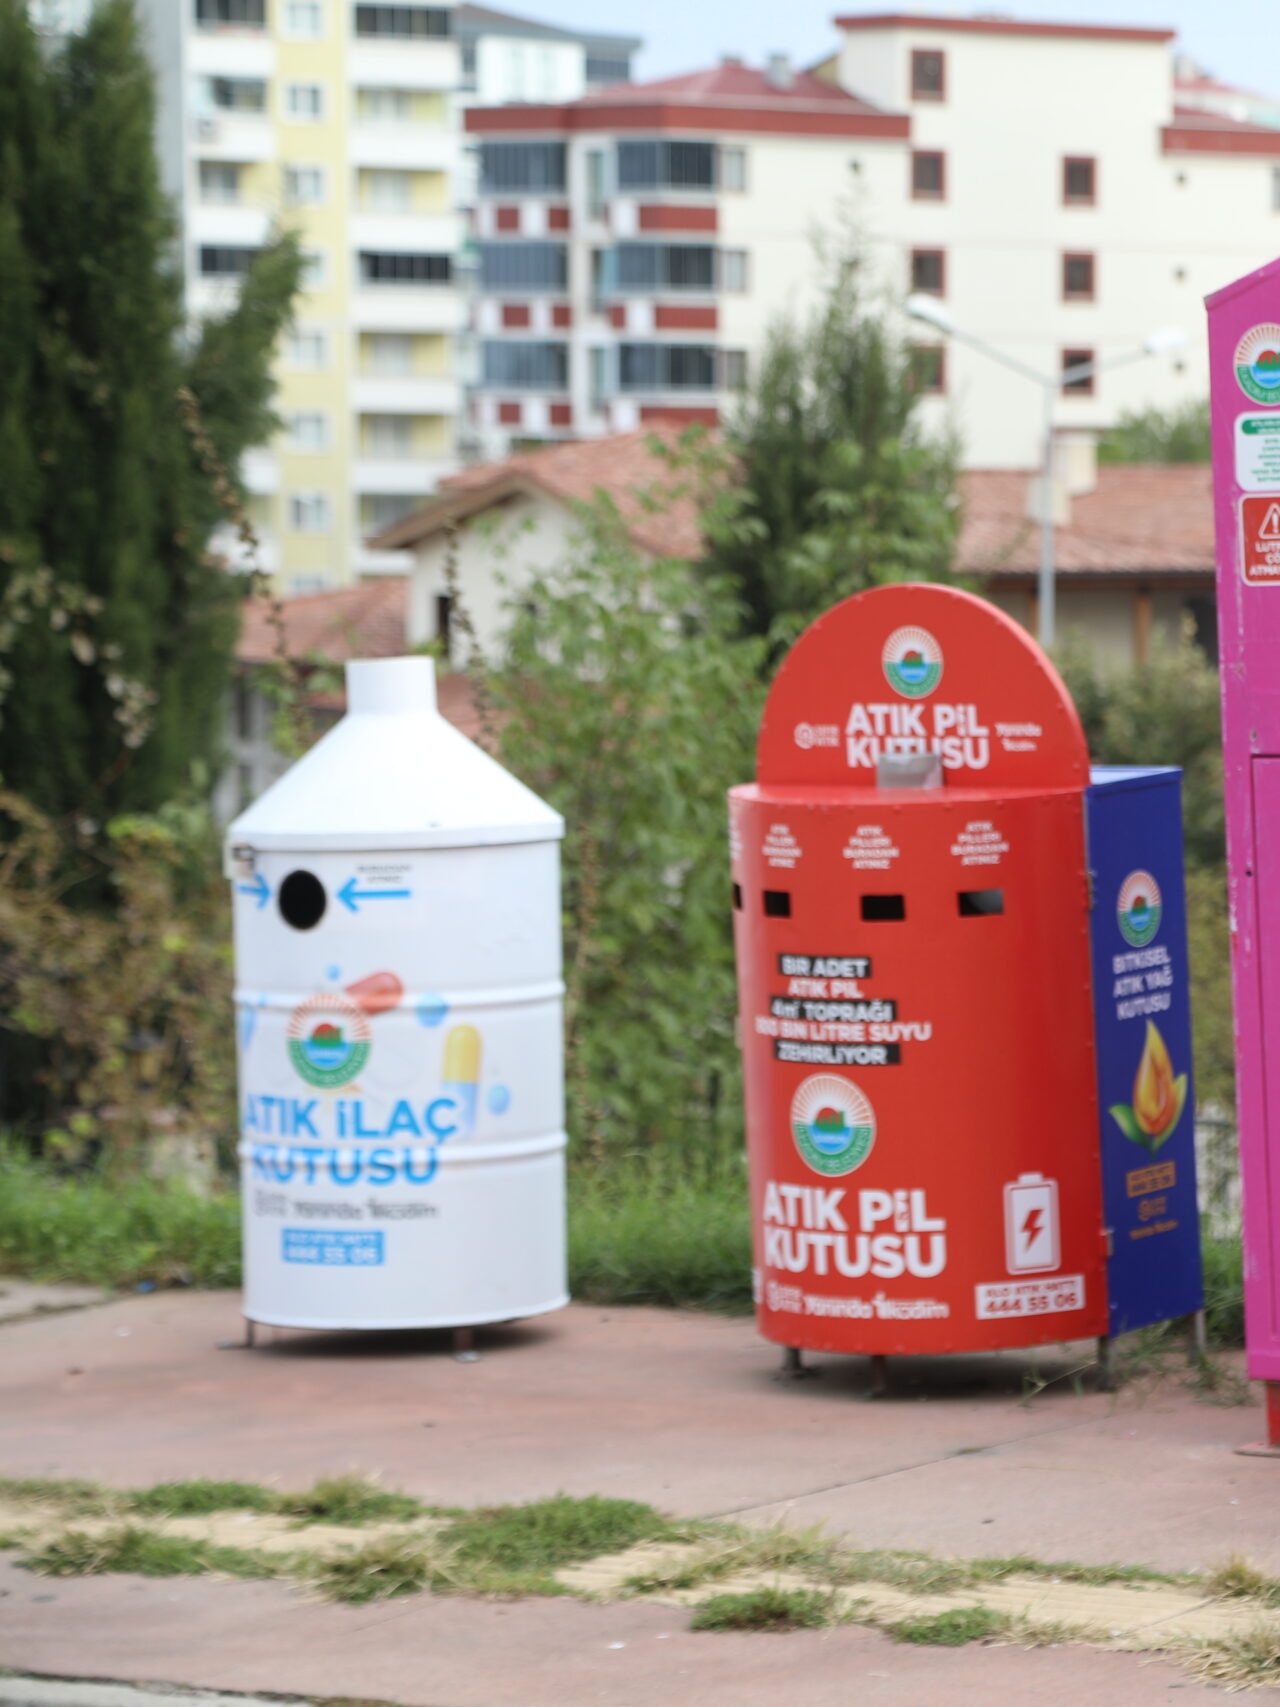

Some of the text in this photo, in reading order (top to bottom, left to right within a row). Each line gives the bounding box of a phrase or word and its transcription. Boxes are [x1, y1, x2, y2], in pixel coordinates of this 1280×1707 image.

[845, 702, 927, 737] ATIK
[812, 957, 869, 978] ADET
[802, 998, 893, 1023] TOPRAĞI
[869, 1022, 932, 1042] SUYU
[762, 1180, 849, 1232] ATIK
[763, 1224, 947, 1279] KUTUSU
